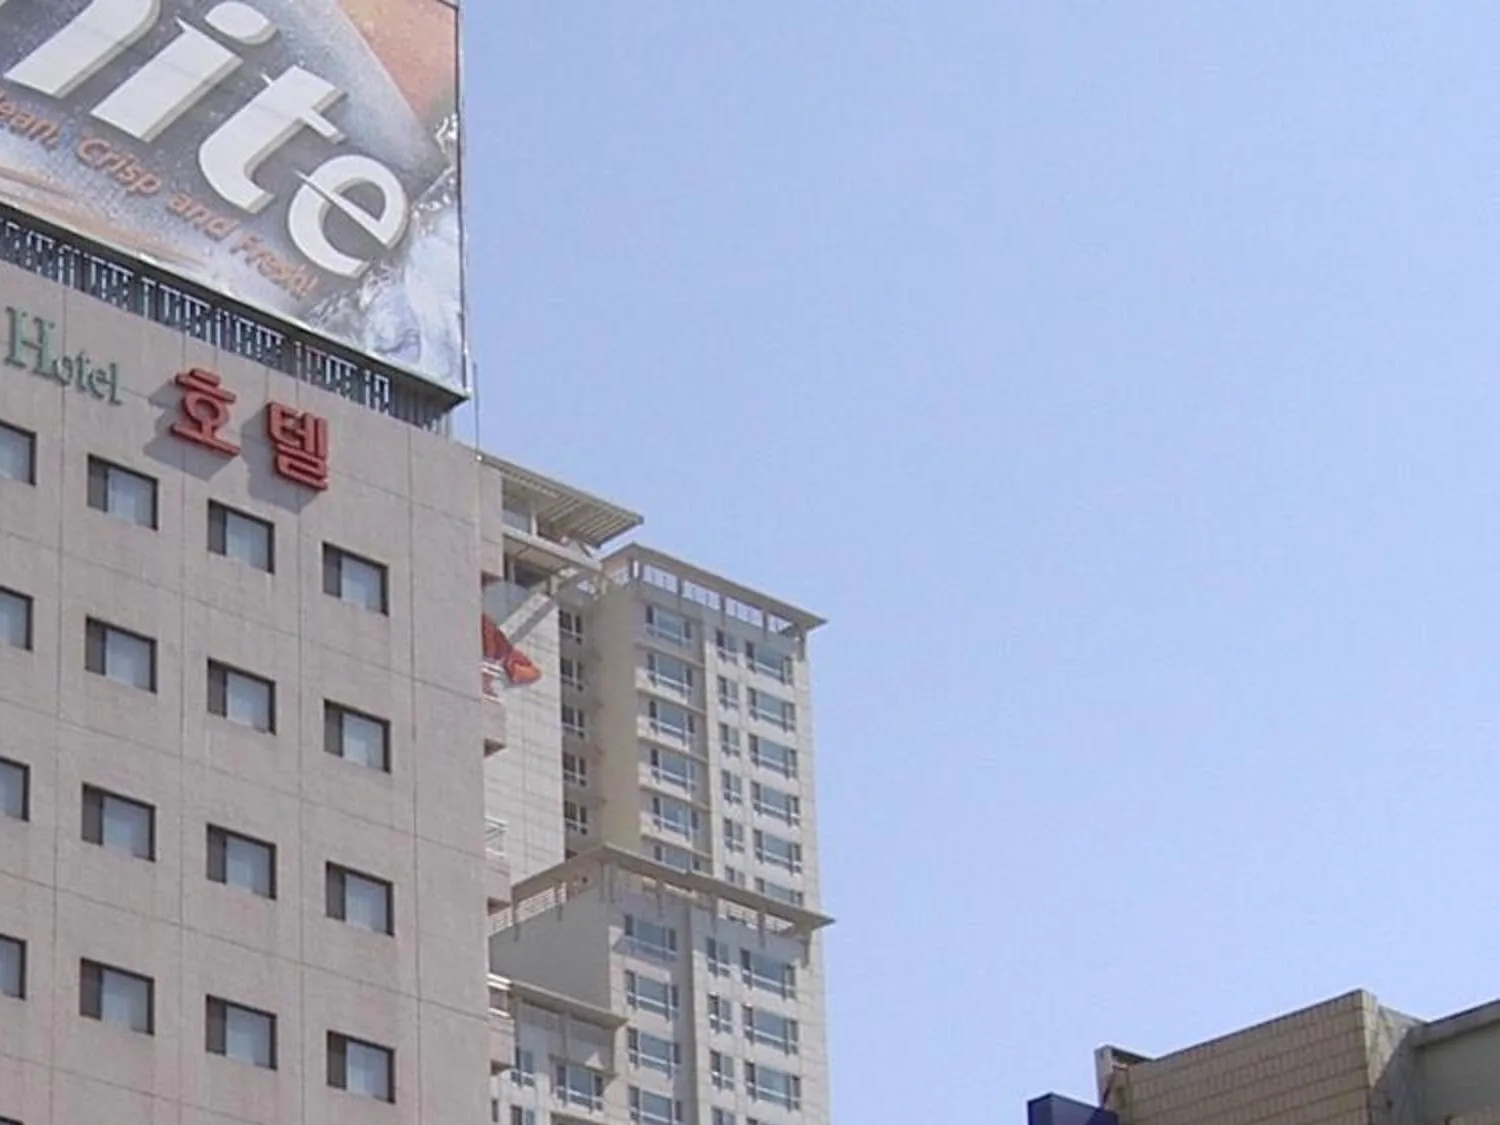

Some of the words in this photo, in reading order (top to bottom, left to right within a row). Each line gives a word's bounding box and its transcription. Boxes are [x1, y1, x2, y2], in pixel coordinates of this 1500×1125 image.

[76, 134, 164, 198] Crisp
[167, 191, 241, 243] and
[4, 306, 124, 407] Hotel
[169, 367, 330, 493] 호텔
